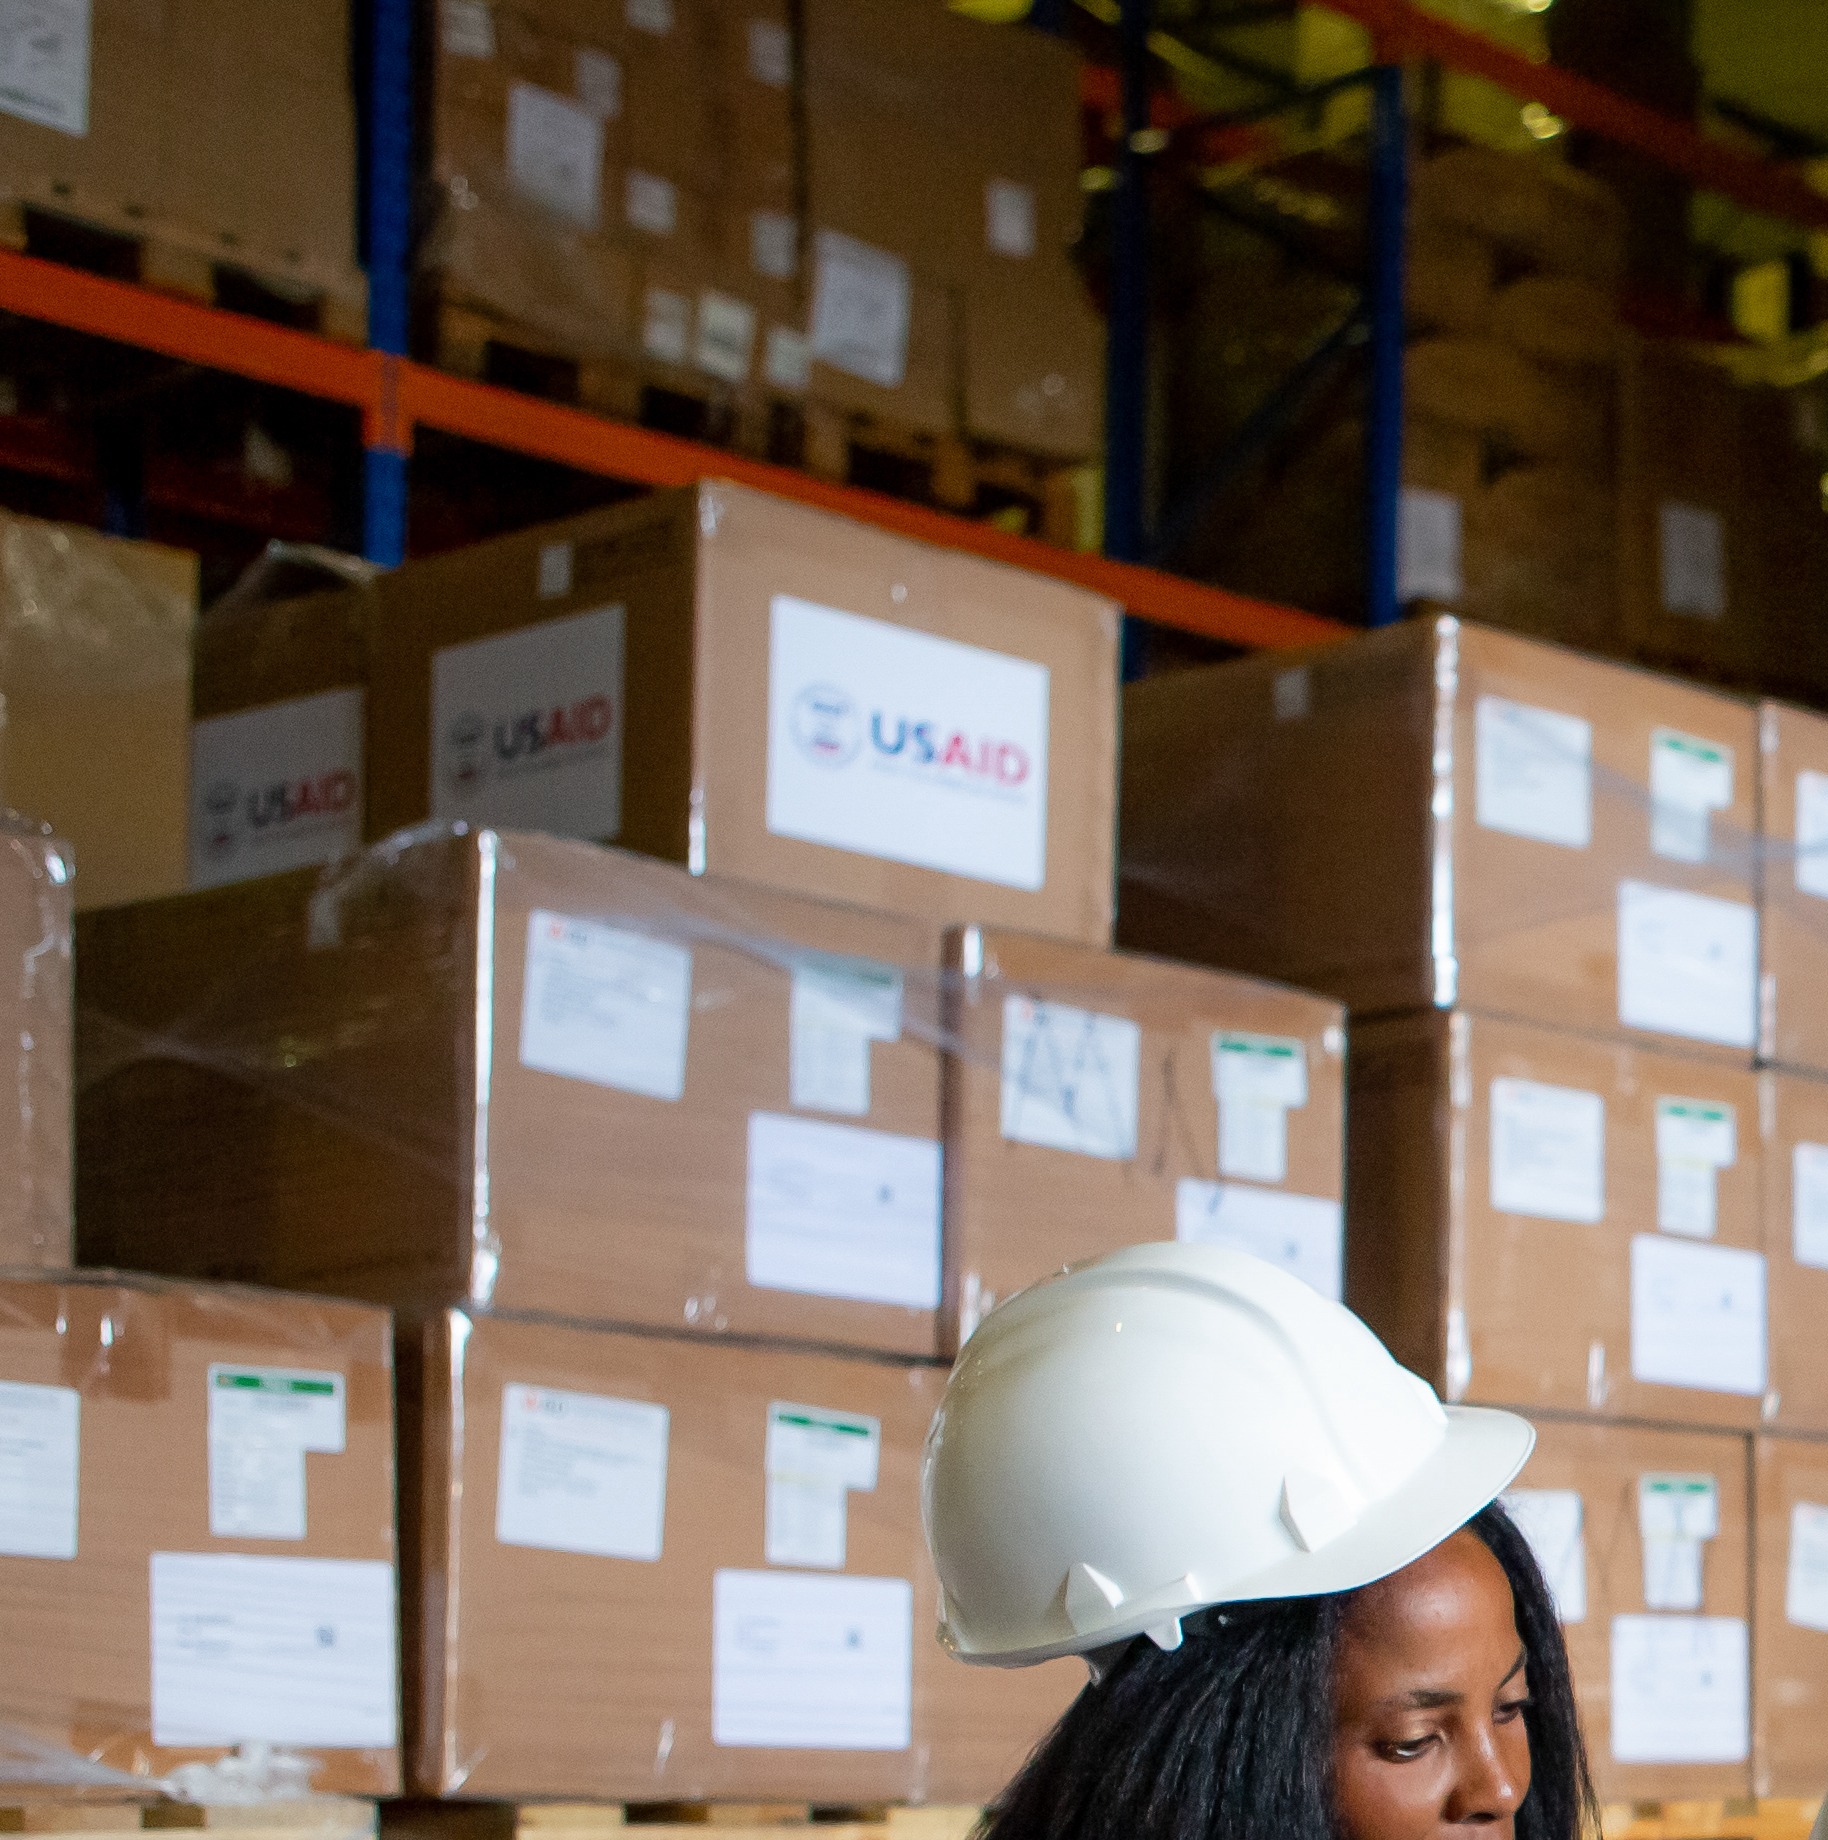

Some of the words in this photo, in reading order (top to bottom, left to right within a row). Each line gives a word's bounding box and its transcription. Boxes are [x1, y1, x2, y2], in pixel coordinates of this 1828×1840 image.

[493, 694, 614, 761] USAID
[869, 709, 1031, 788] USAID
[246, 766, 357, 829] USAID
